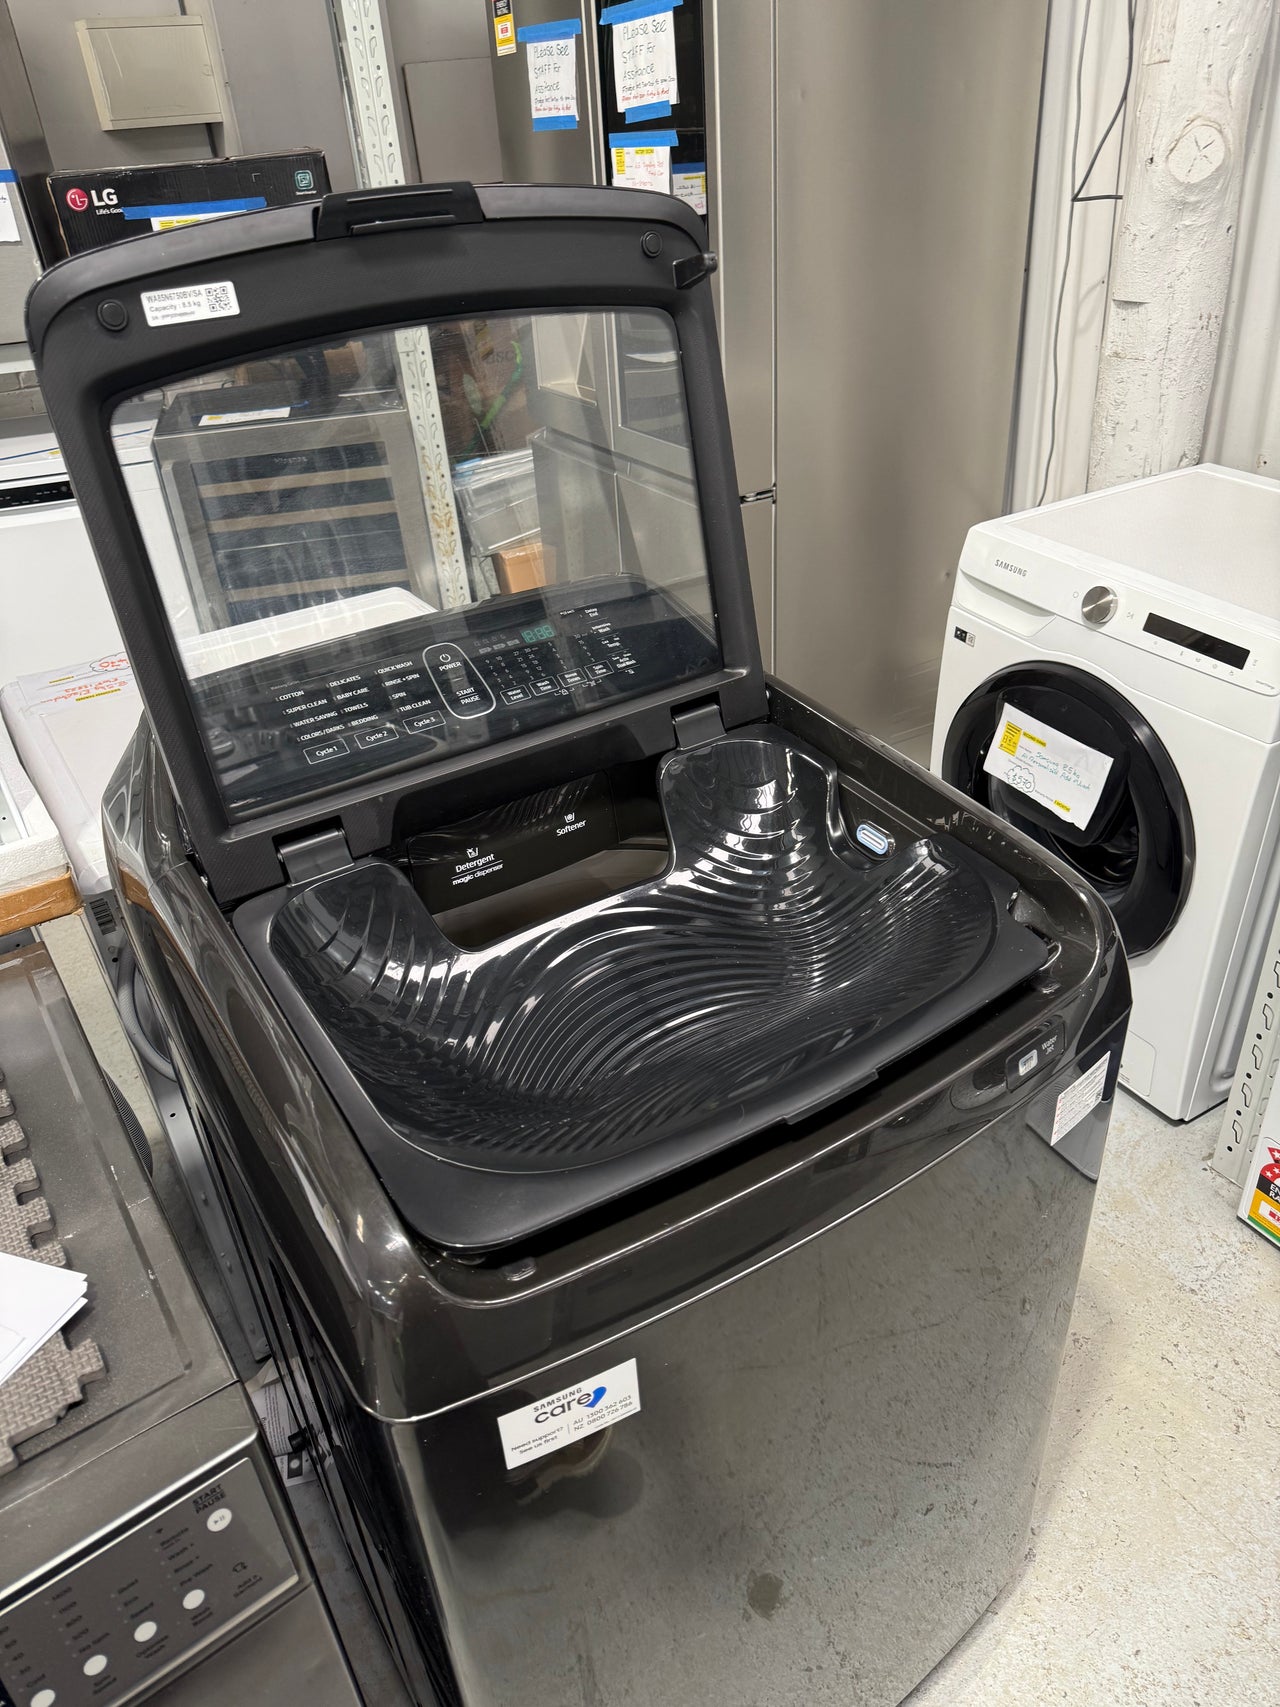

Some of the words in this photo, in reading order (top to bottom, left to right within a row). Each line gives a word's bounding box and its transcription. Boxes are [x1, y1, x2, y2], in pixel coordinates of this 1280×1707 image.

[90, 188, 118, 206] LG
[149, 304, 177, 312] Capacity
[994, 559, 1028, 576] SAMSUNG
[378, 665, 395, 674] QUICK
[395, 660, 414, 670] WASH
[439, 661, 462, 672] POWER
[328, 675, 362, 688] DELICATES
[384, 678, 402, 686] RINSE
[279, 690, 304, 702] COTTON
[336, 692, 352, 700] BABY
[353, 687, 370, 696] CARE
[392, 692, 407, 700] SPIN
[456, 687, 475, 696] START
[399, 704, 412, 712] TUB
[412, 700, 432, 709] CLEAN
[460, 695, 480, 704] PAUSE
[286, 703, 307, 715] SUPER
[306, 698, 328, 709] CLEAN
[344, 702, 369, 714] TOWELS
[292, 716, 315, 728] WATER
[314, 710, 338, 722] SAVING
[351, 714, 378, 727] BEDDING
[414, 719, 428, 728] Cycle
[366, 732, 382, 742] Cycle
[382, 730, 388, 738] 2
[316, 746, 333, 757] Cycle
[1012, 773, 1032, 790] $570
[556, 820, 587, 836] Softener
[456, 854, 495, 873] Detergent
[452, 874, 474, 886] magic
[474, 863, 504, 878] dispenser
[534, 1387, 582, 1413] SAMSUNG
[534, 1392, 592, 1424] care
[586, 1408, 604, 1419] 1300
[604, 1402, 618, 1411] 362
[618, 1395, 632, 1404] 603
[587, 1414, 606, 1426] 0800
[511, 1440, 531, 1452] Need
[532, 1426, 564, 1443] support?
[520, 1446, 533, 1454] See
[544, 1435, 558, 1444] first
[192, 1484, 222, 1505] START
[196, 1490, 226, 1514] PAUSE
